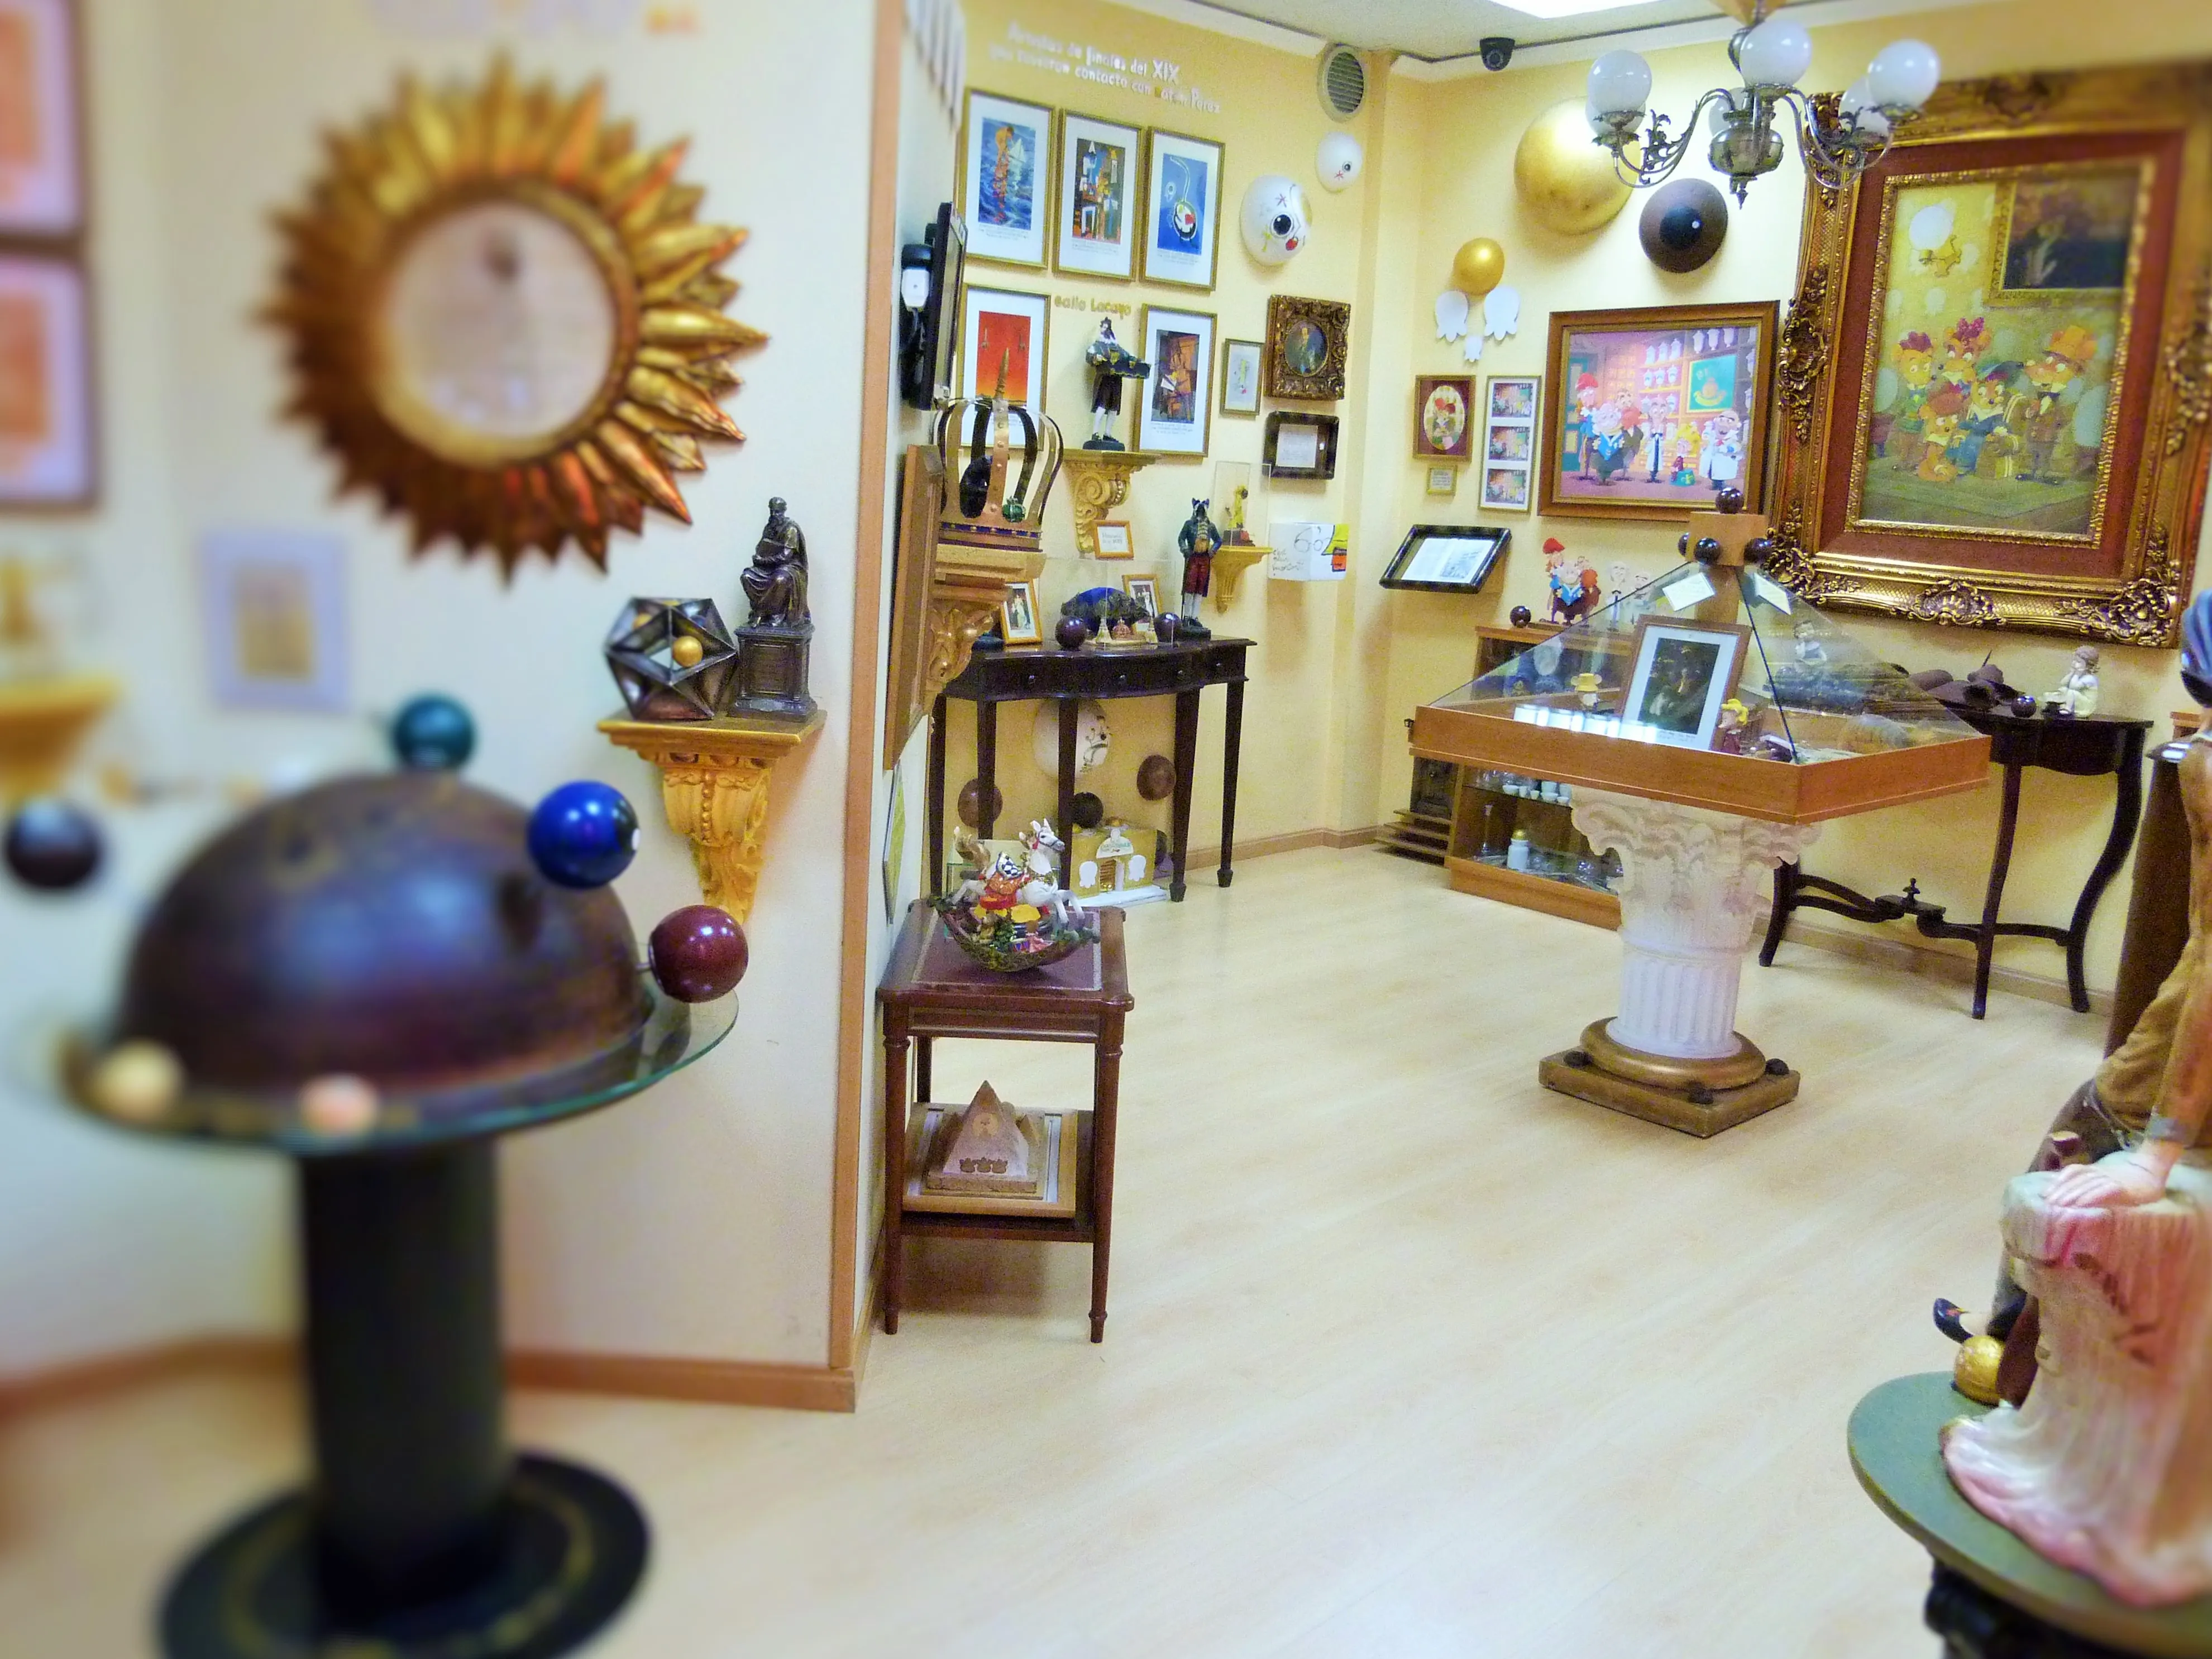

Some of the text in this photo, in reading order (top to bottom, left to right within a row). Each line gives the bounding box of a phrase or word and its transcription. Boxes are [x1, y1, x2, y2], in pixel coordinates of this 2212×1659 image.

[1074, 66, 1127, 88] contacto
[1086, 45, 1126, 71] finales
[1130, 59, 1146, 77] del
[1152, 58, 1179, 84] XIX
